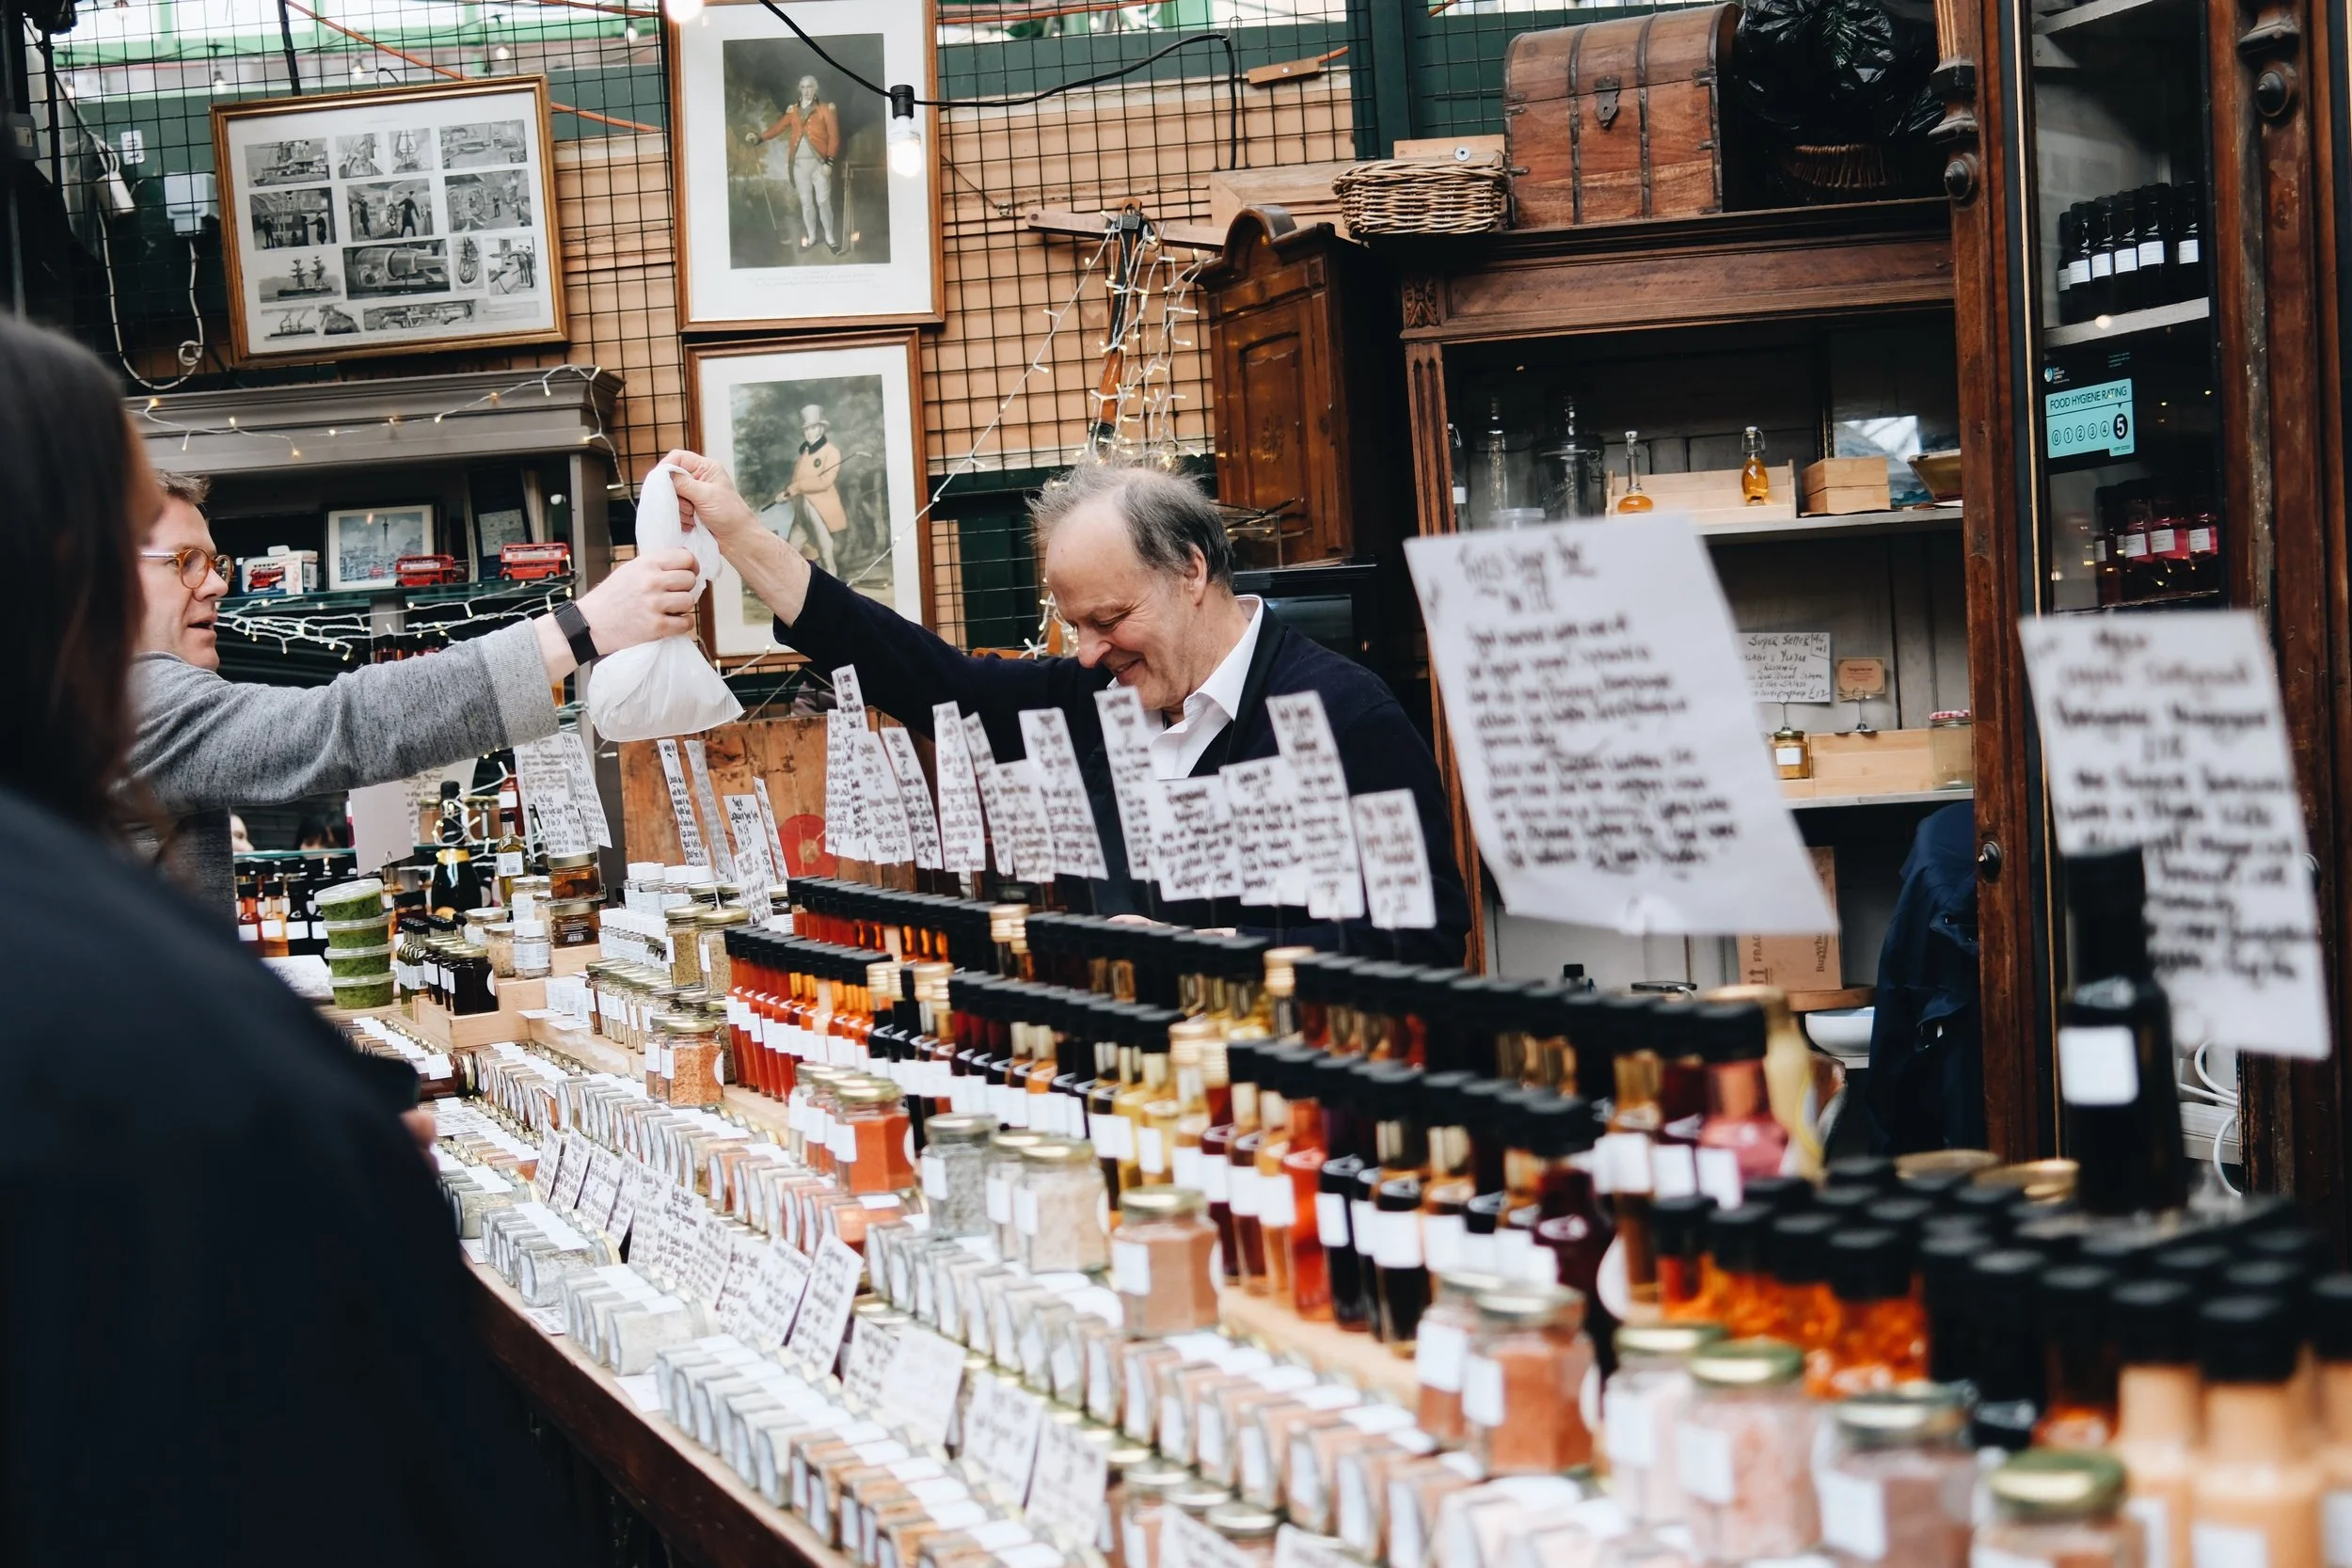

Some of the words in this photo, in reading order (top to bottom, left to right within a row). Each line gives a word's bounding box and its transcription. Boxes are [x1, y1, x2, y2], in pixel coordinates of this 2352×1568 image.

[2050, 398, 2070, 409] FOOD
[2072, 391, 2100, 405] HYGIENE
[2102, 387, 2126, 400] RATING
